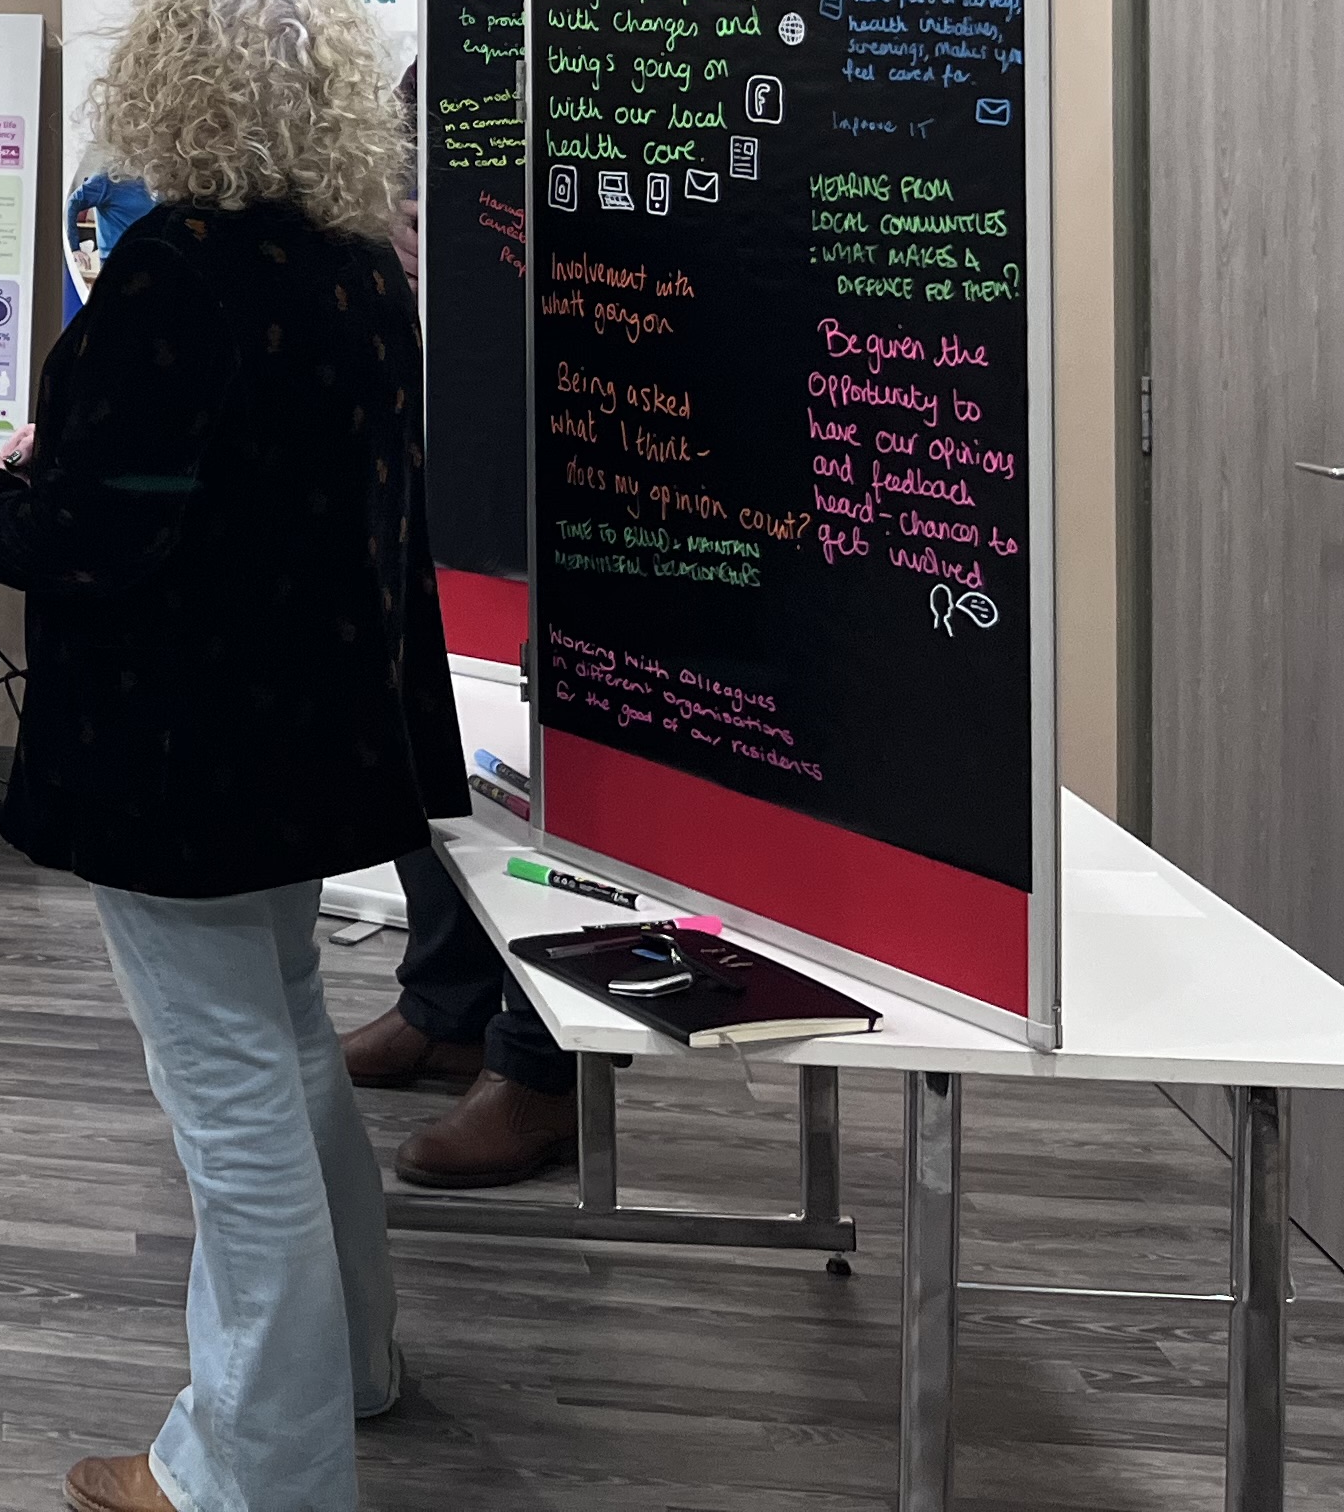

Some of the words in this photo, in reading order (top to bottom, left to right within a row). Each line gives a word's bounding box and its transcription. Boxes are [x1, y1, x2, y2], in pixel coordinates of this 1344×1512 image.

[715, 5, 761, 37] and
[848, 14, 908, 33] health
[548, 46, 615, 90] things
[633, 52, 691, 93] going
[704, 58, 729, 81] on
[889, 65, 935, 82] cared
[439, 99, 479, 114] Being
[614, 107, 656, 124] our
[668, 101, 728, 130] local
[445, 138, 483, 156] Being
[546, 129, 627, 160] health
[900, 176, 954, 203] FROM
[812, 209, 869, 232] LOCAL
[551, 252, 648, 291] Involvement
[656, 269, 695, 298] with
[888, 244, 958, 268] MAKES
[964, 248, 981, 272] A
[925, 279, 955, 302] FOR
[594, 303, 640, 343] going
[643, 314, 673, 333] on
[817, 318, 862, 357] Be
[866, 328, 924, 374] given
[933, 334, 989, 367] the
[557, 361, 616, 414] Being
[627, 384, 691, 419] asked
[952, 388, 982, 421] to
[807, 406, 861, 446] have
[636, 426, 691, 462] think
[813, 453, 854, 485] and
[567, 454, 606, 490] does
[649, 485, 727, 520] opinion
[556, 518, 592, 540] TIME
[598, 523, 616, 544] TO
[624, 526, 669, 552] BUILD
[814, 484, 874, 523] heard
[988, 527, 1018, 556] to
[818, 524, 869, 564] get
[549, 623, 615, 671] Working
[624, 651, 669, 680] with
[575, 659, 653, 694] different
[585, 691, 610, 712] the
[618, 703, 653, 727] good
[663, 718, 678, 733] of
[732, 739, 823, 782] residents
